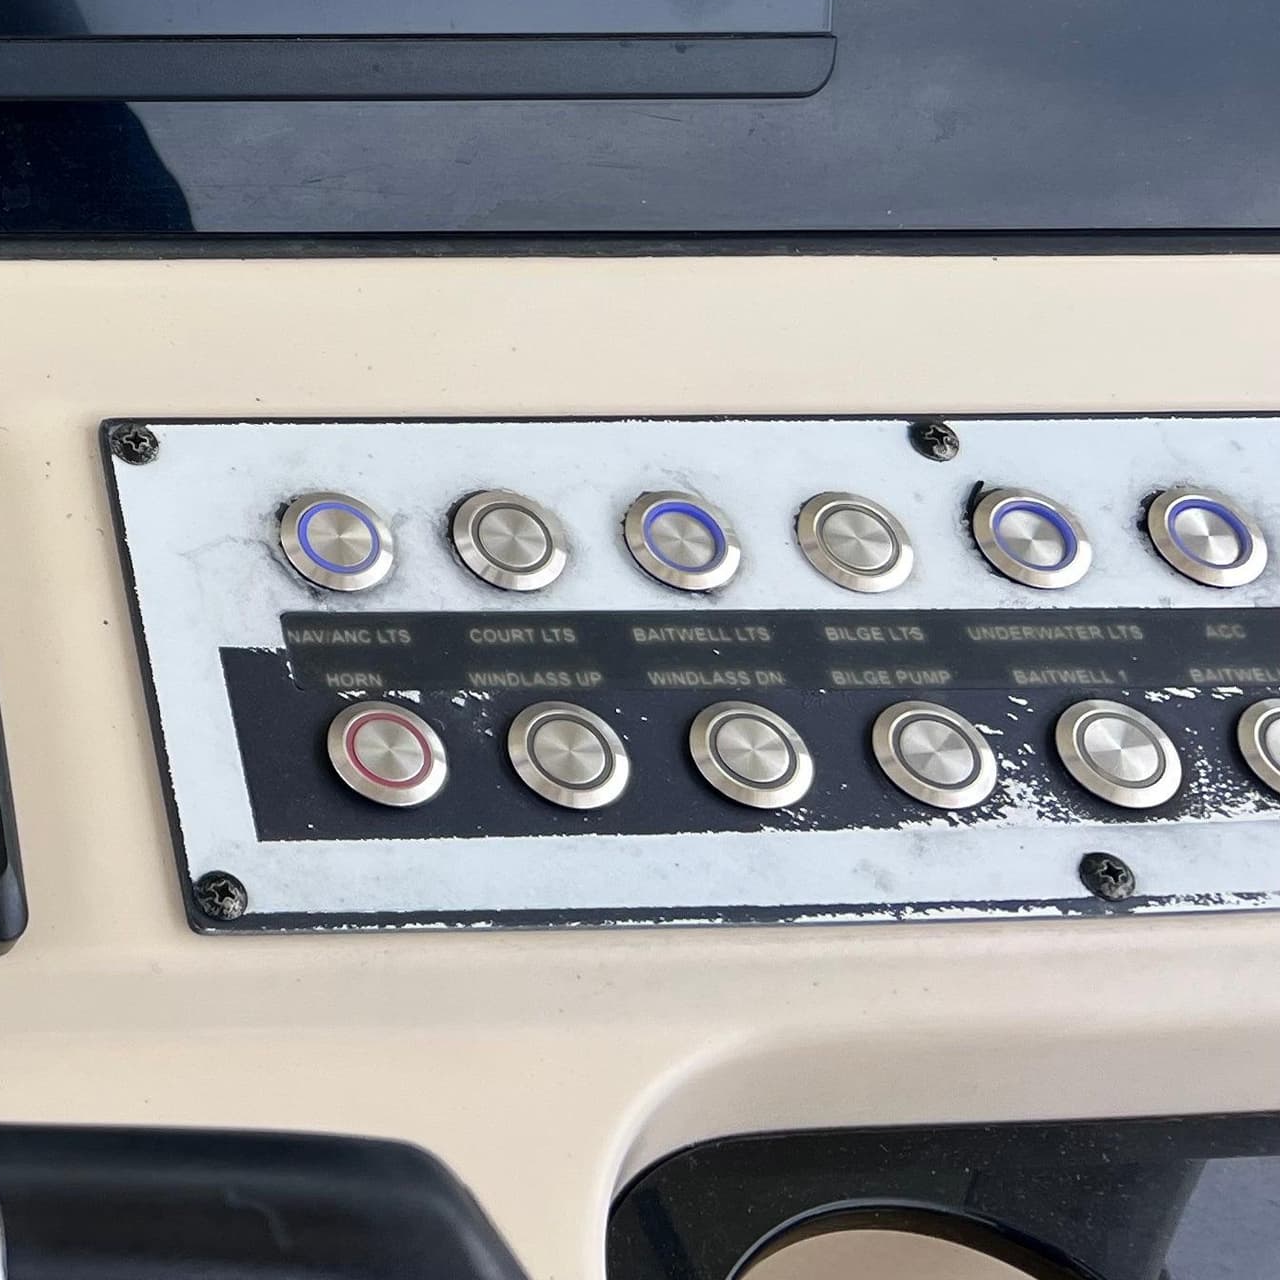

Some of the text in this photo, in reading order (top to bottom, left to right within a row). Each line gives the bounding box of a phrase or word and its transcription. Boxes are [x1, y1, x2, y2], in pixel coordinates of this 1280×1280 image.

[377, 628, 411, 643] LTS
[469, 628, 576, 643] COURT LTS
[633, 627, 770, 642] BAITWELL LTS
[825, 626, 924, 642] BILGE LTS
[967, 625, 1143, 641] UNDERWATER LTS
[1205, 624, 1246, 639] ACC
[326, 672, 383, 687] HORN
[468, 672, 603, 687] WINDLASS UP
[647, 671, 784, 686] WINDLASS DN
[832, 670, 951, 686] BILGE PUMP
[1013, 670, 1115, 685] BAITWELL
[1190, 668, 1280, 683] BAITWEL
